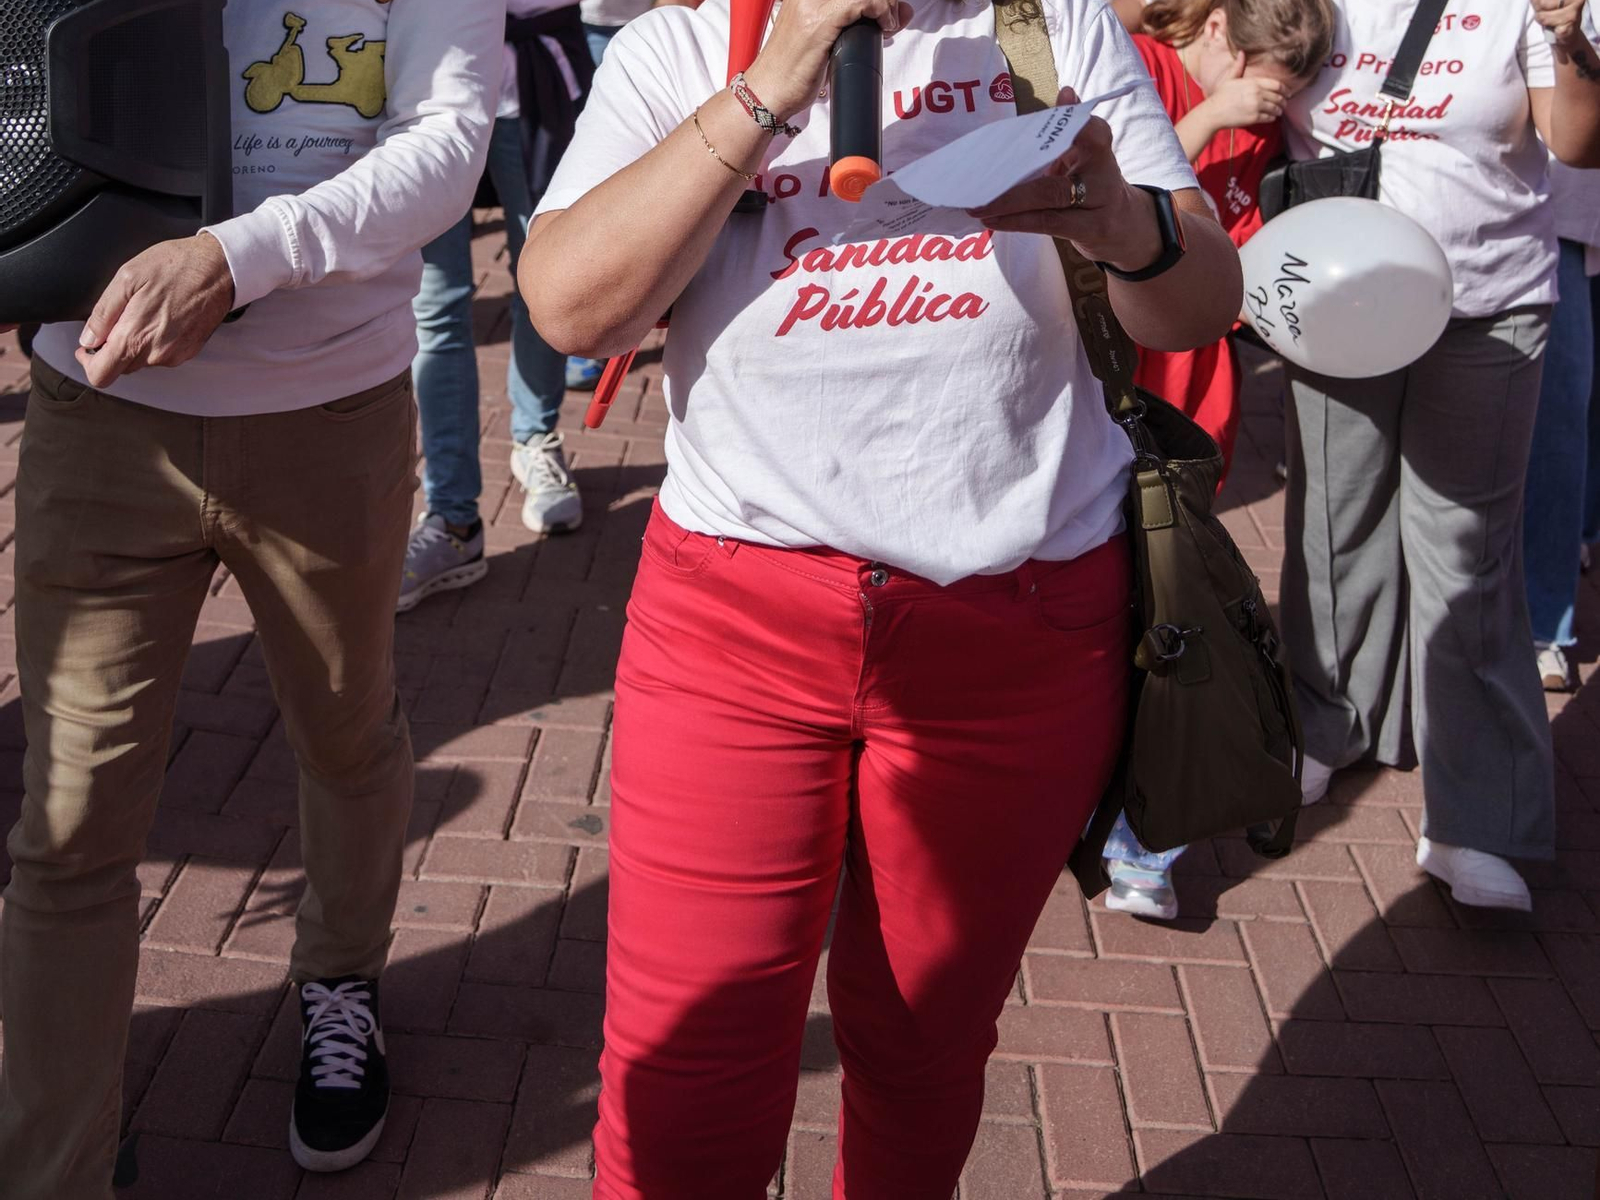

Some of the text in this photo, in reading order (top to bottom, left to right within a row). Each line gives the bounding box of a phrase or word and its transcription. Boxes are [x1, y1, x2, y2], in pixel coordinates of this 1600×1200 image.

[1356, 52, 1464, 76] Priero
[893, 79, 981, 120] UGT
[234, 133, 354, 157] Life is a journey
[770, 228, 993, 280] Sanidad
[775, 275, 989, 337] Pública
